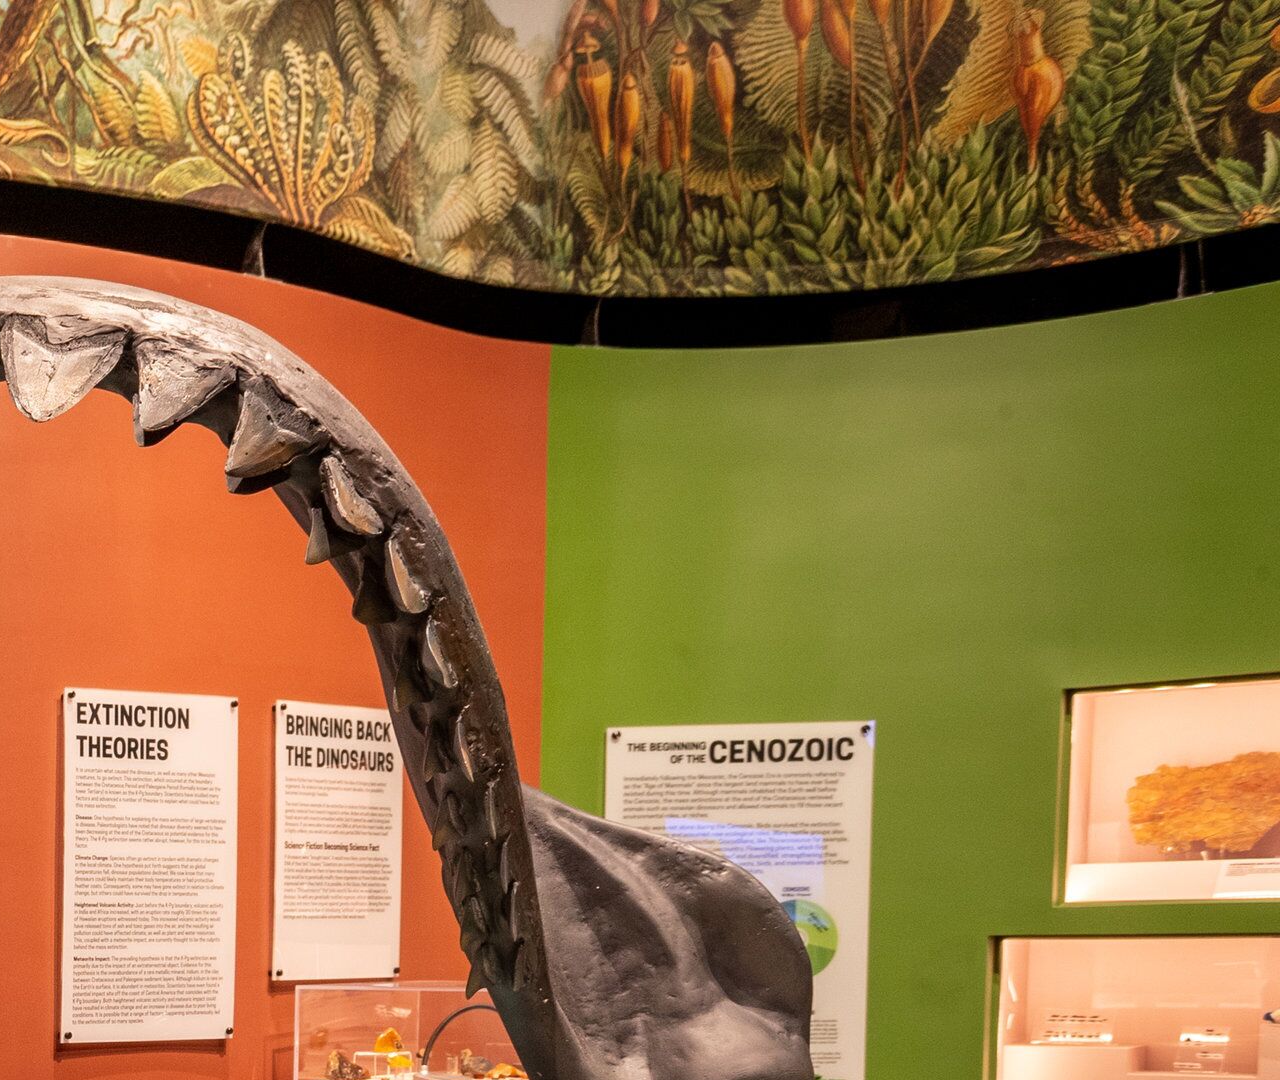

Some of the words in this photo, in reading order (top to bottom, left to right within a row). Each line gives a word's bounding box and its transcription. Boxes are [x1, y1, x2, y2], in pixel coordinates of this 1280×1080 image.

[76, 702, 190, 730] EXTINCTION
[286, 714, 352, 739] BRINGING
[356, 720, 391, 742] BACK
[76, 734, 169, 761] THEORIES
[286, 746, 312, 767] THE
[316, 748, 394, 772] DINOSAURS
[627, 743, 646, 752] THE
[649, 742, 707, 752] BEGINNING
[670, 754, 684, 764] OF
[686, 753, 706, 763] THE
[709, 738, 854, 764] CENOZOIC
[305, 842, 323, 850] Fiction
[324, 842, 348, 852] Becoming
[349, 843, 368, 851] Science
